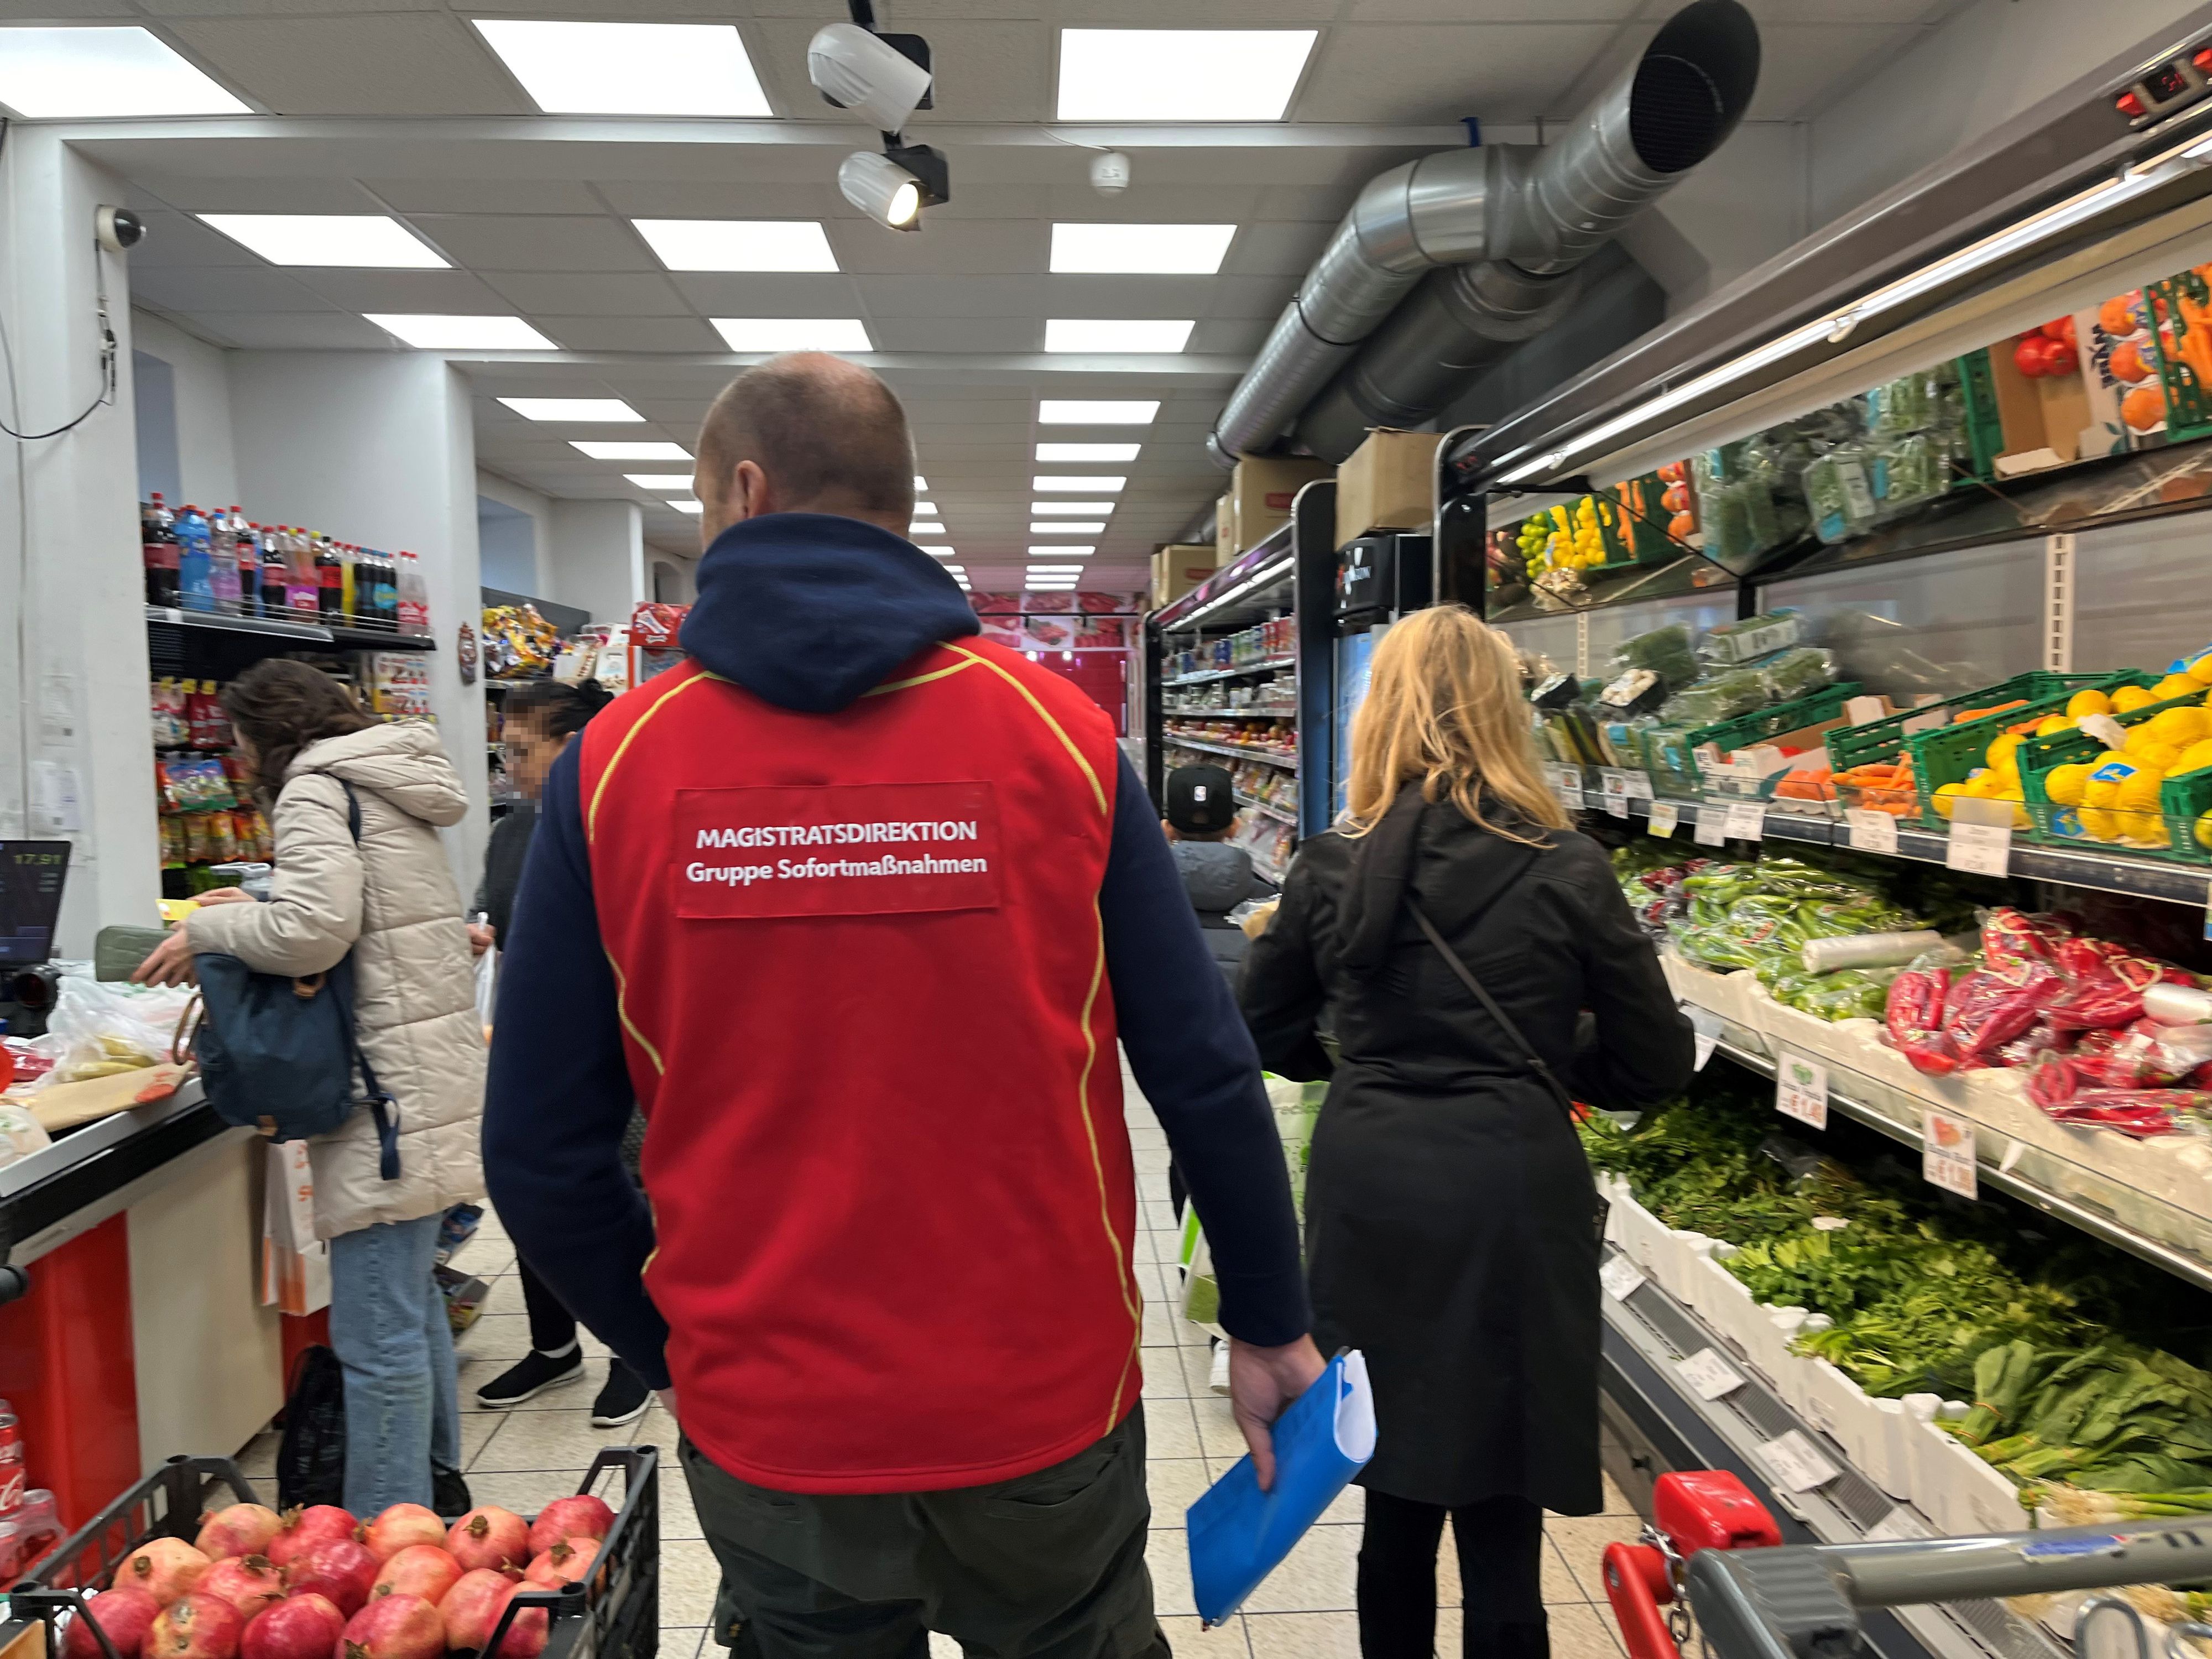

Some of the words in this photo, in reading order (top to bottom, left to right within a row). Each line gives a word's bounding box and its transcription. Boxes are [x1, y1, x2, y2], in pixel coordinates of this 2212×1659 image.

[696, 821, 977, 849] MAGISTRATSDIREKTION
[686, 862, 774, 887] Gruppe
[776, 853, 988, 879] Sofortmaßnahmen
